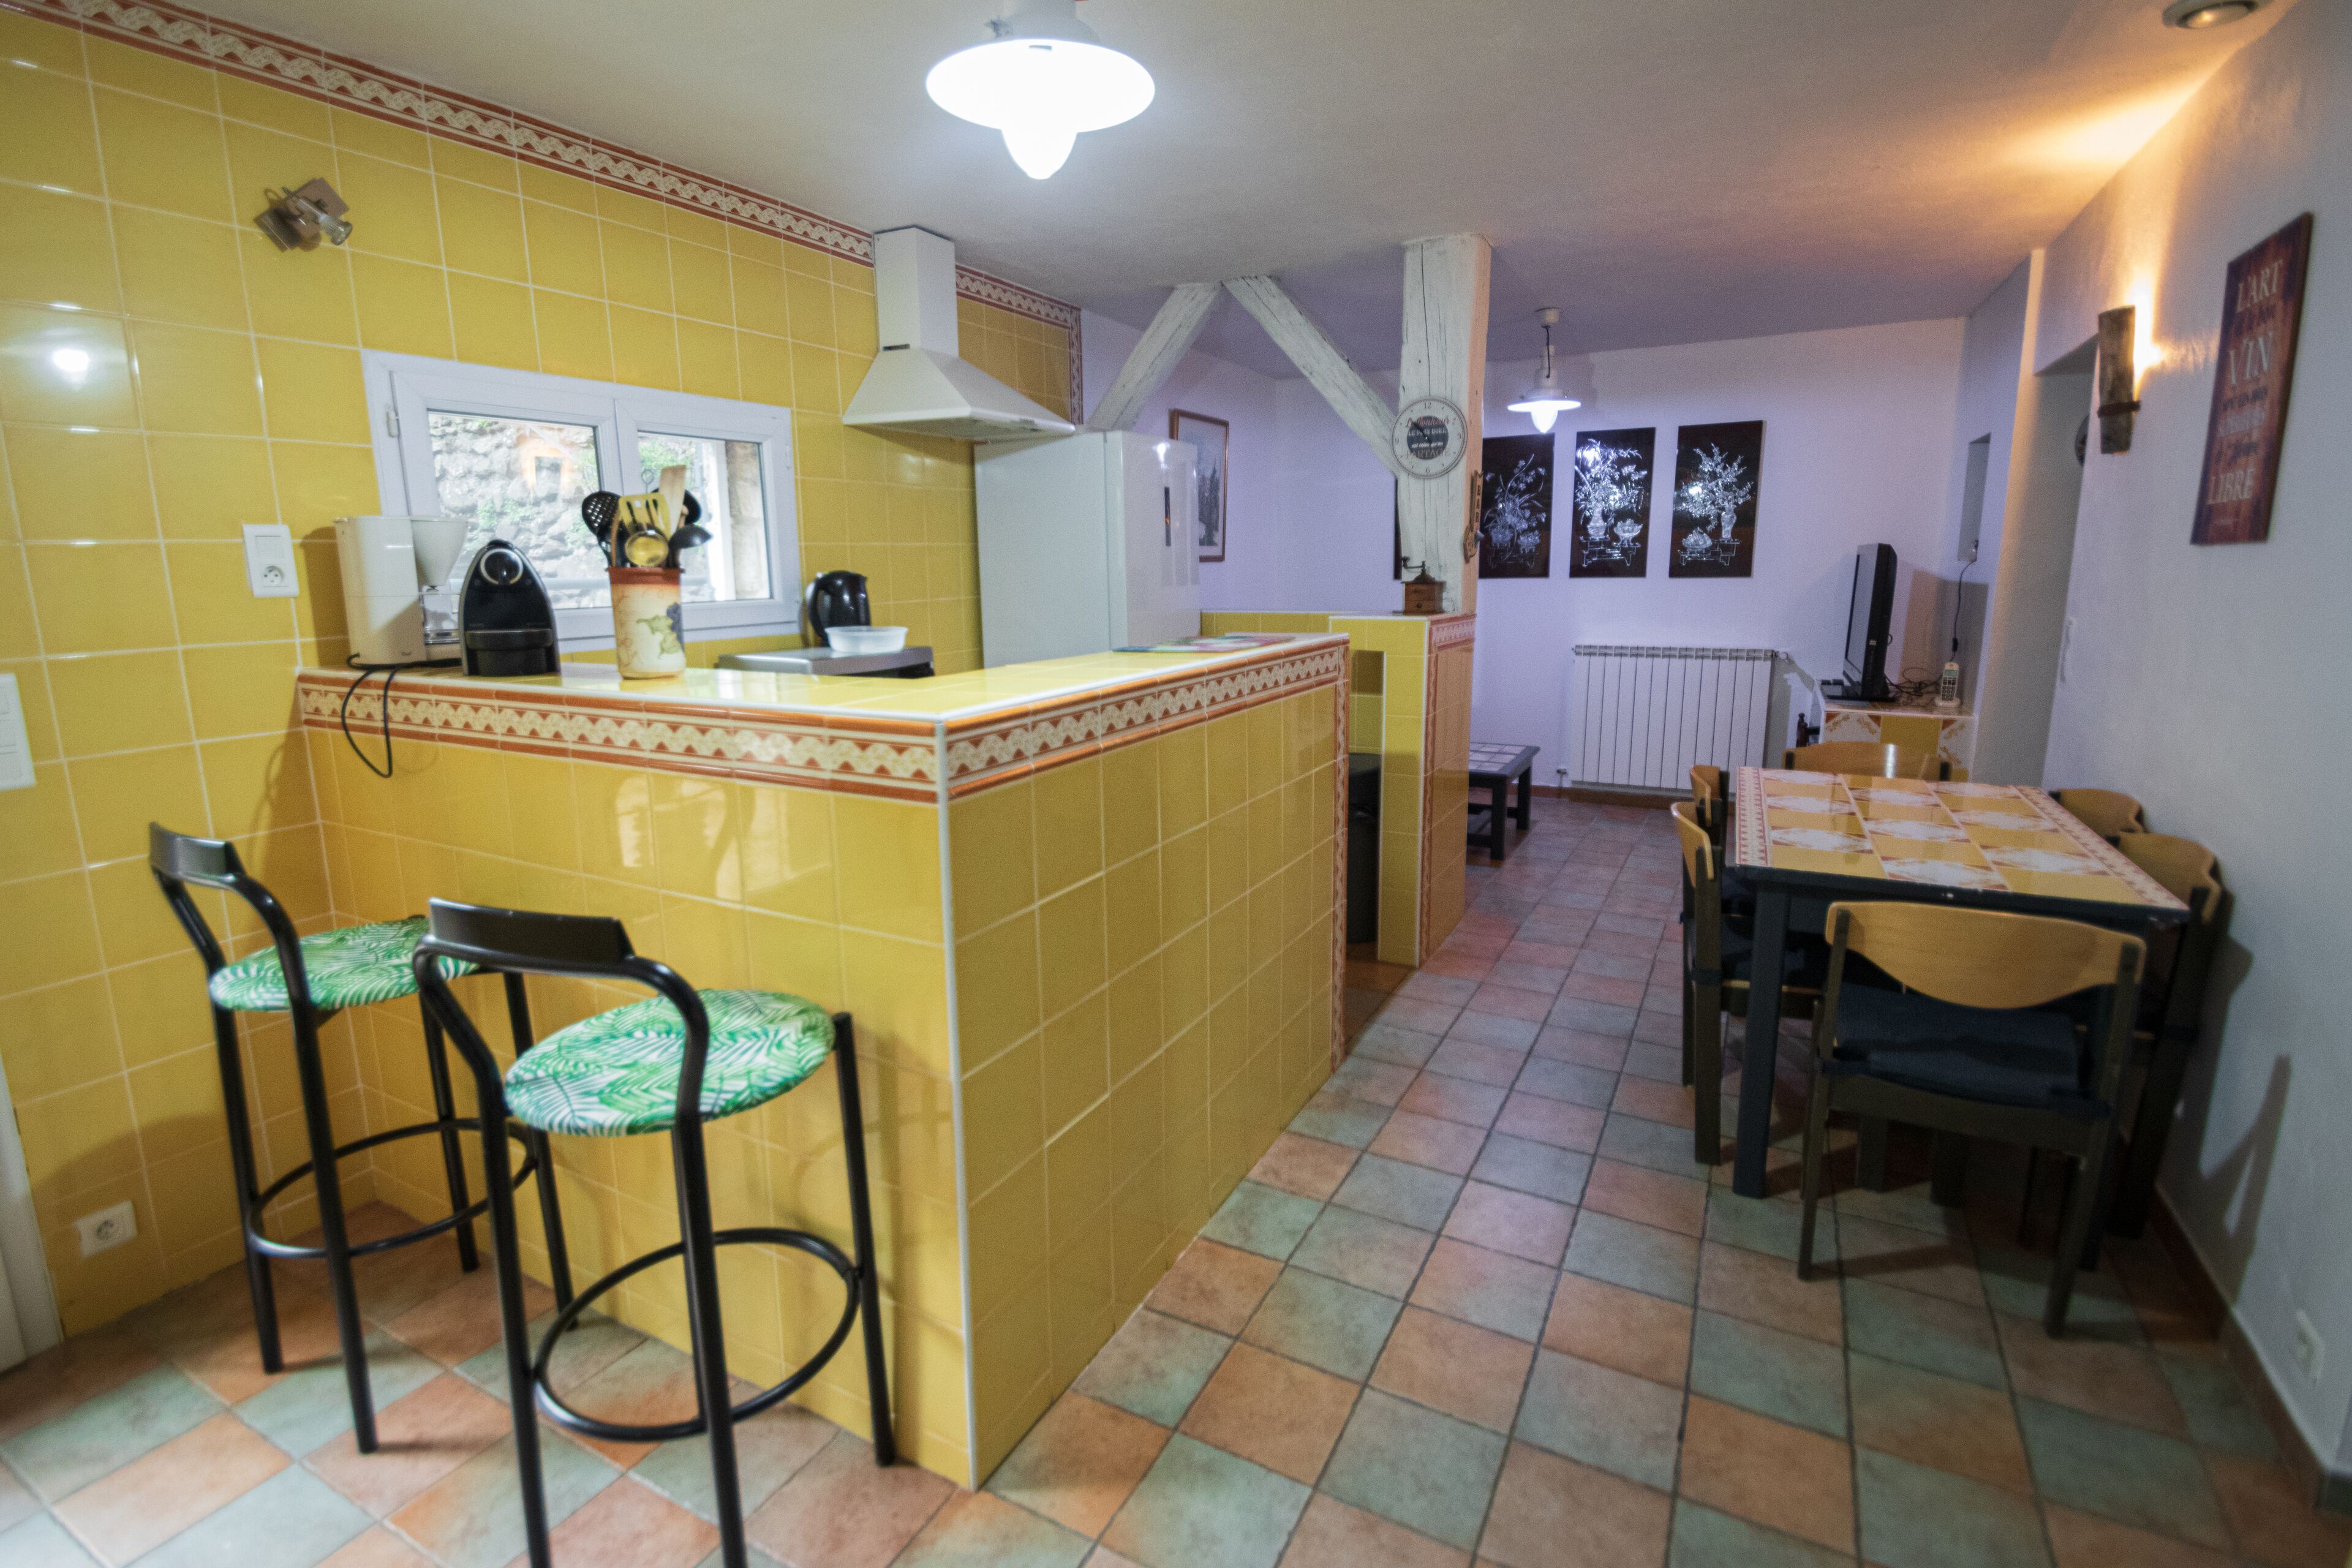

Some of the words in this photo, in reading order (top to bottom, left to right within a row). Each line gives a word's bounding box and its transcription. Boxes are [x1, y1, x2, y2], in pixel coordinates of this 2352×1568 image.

[2236, 259, 2283, 313] L'ART
[2230, 330, 2274, 385] VIN
[2206, 467, 2255, 505] LIBRE
